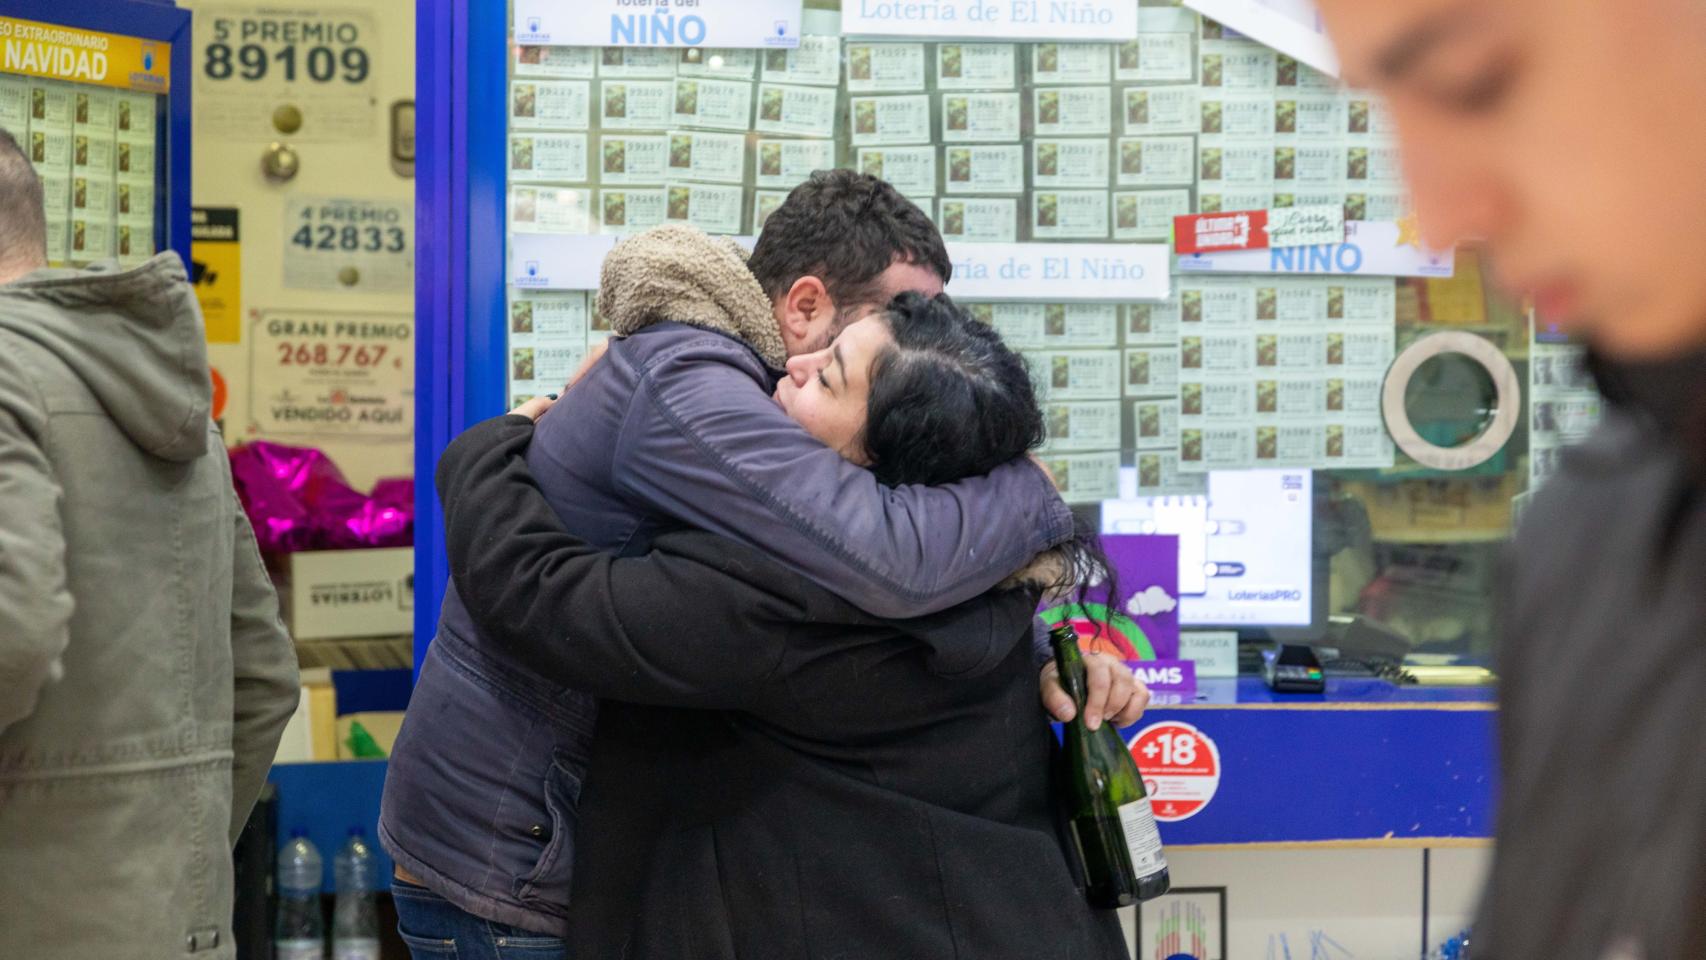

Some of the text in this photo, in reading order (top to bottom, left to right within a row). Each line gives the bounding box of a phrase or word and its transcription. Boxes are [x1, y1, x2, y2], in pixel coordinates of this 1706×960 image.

[967, 0, 999, 22] de
[1009, 0, 1038, 23] El
[1049, 1, 1113, 25] Niño
[14, 23, 109, 51] EXTRAORDINARIO
[241, 20, 358, 44] PREMIO
[610, 8, 706, 45] NIÑO
[4, 40, 108, 81] NAVIDAD
[204, 43, 370, 84] 89109
[320, 207, 399, 223] PREMIO
[293, 225, 405, 252] 42833
[999, 257, 1031, 280] de
[1042, 257, 1069, 280] El
[1080, 257, 1145, 280] Niño
[267, 319, 409, 339] GRAN PREMIO
[272, 406, 351, 423] VENDIDO
[1189, 638, 1230, 649] TARJETA
[1130, 668, 1184, 685] AMS
[1142, 733, 1197, 766] +18
